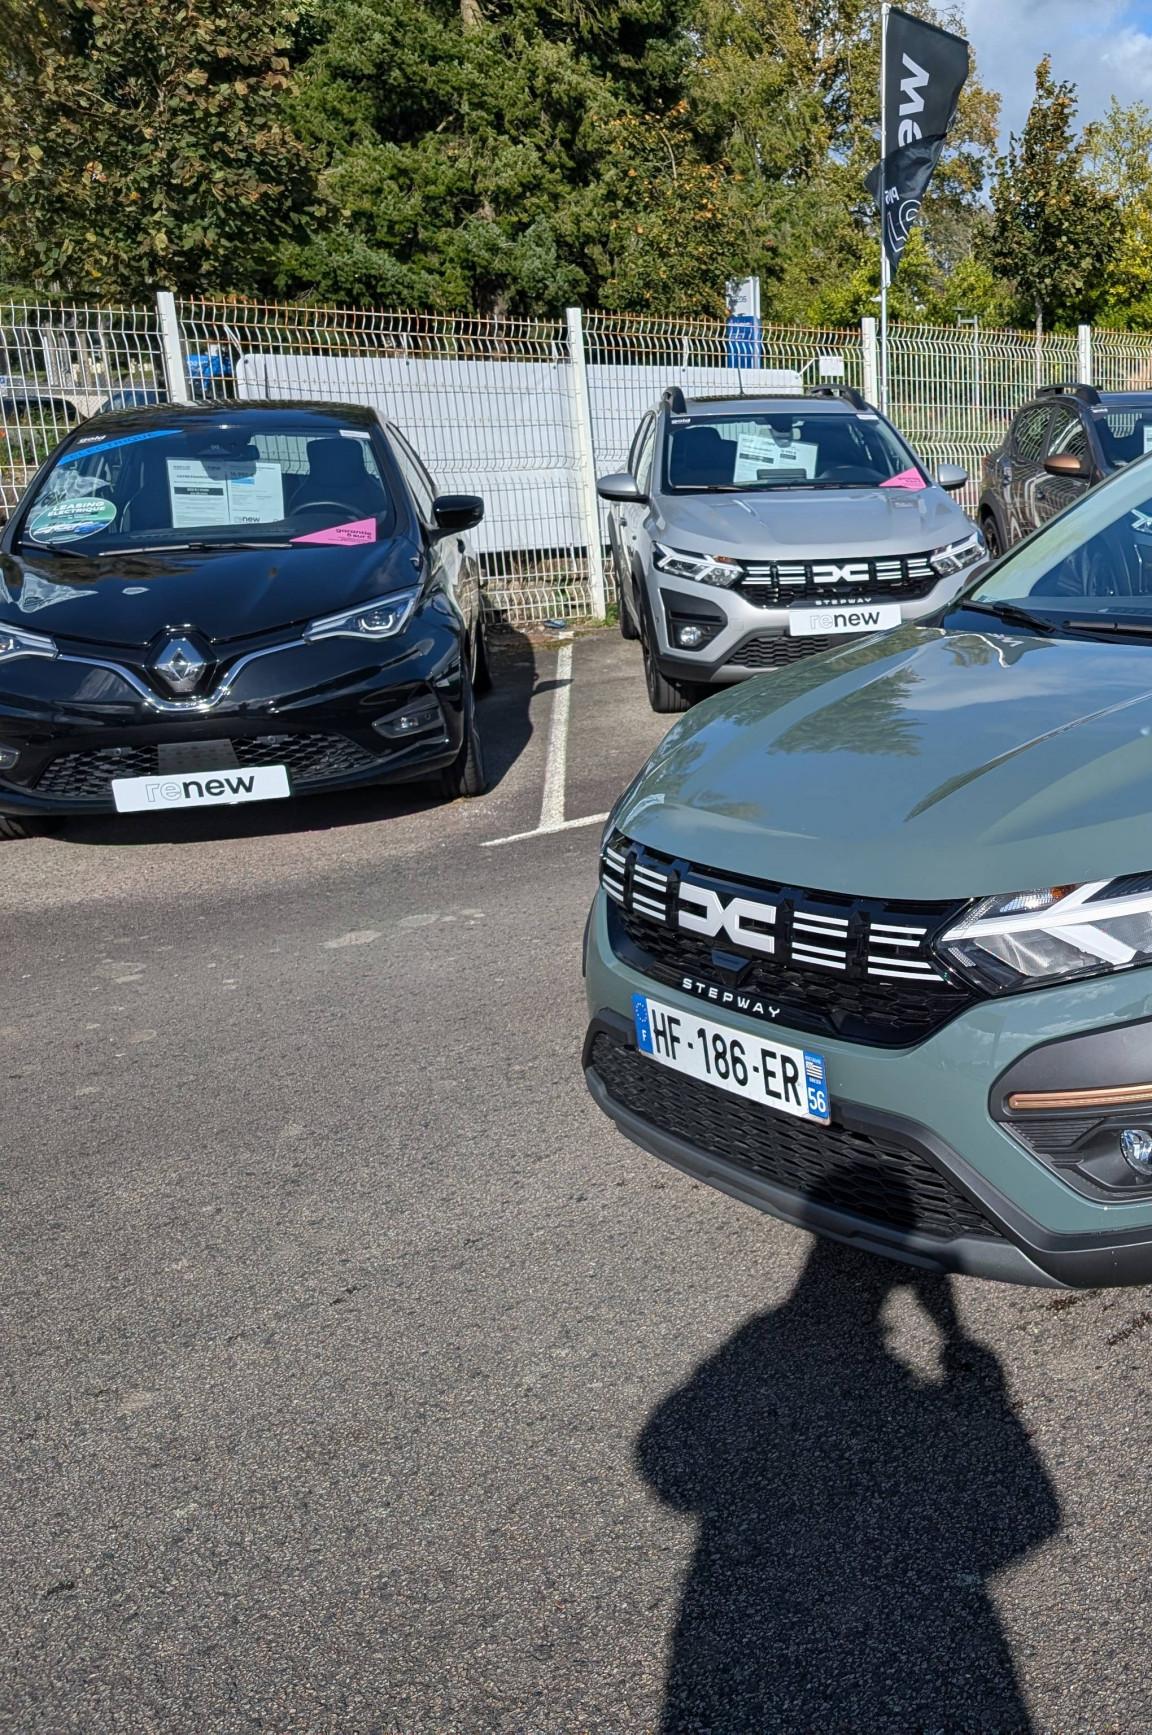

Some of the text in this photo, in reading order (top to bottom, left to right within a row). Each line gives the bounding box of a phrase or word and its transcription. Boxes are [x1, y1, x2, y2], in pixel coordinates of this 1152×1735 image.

[52, 501, 105, 511] LEASING
[335, 528, 372, 536] garantie
[815, 597, 872, 606] STEPWAY
[809, 611, 881, 630] renew
[145, 775, 255, 803] renew
[682, 977, 781, 1018] STEPWAY
[641, 1029, 648, 1042] F
[651, 1009, 802, 1107] HF-186-ER
[807, 1086, 827, 1113] 56
